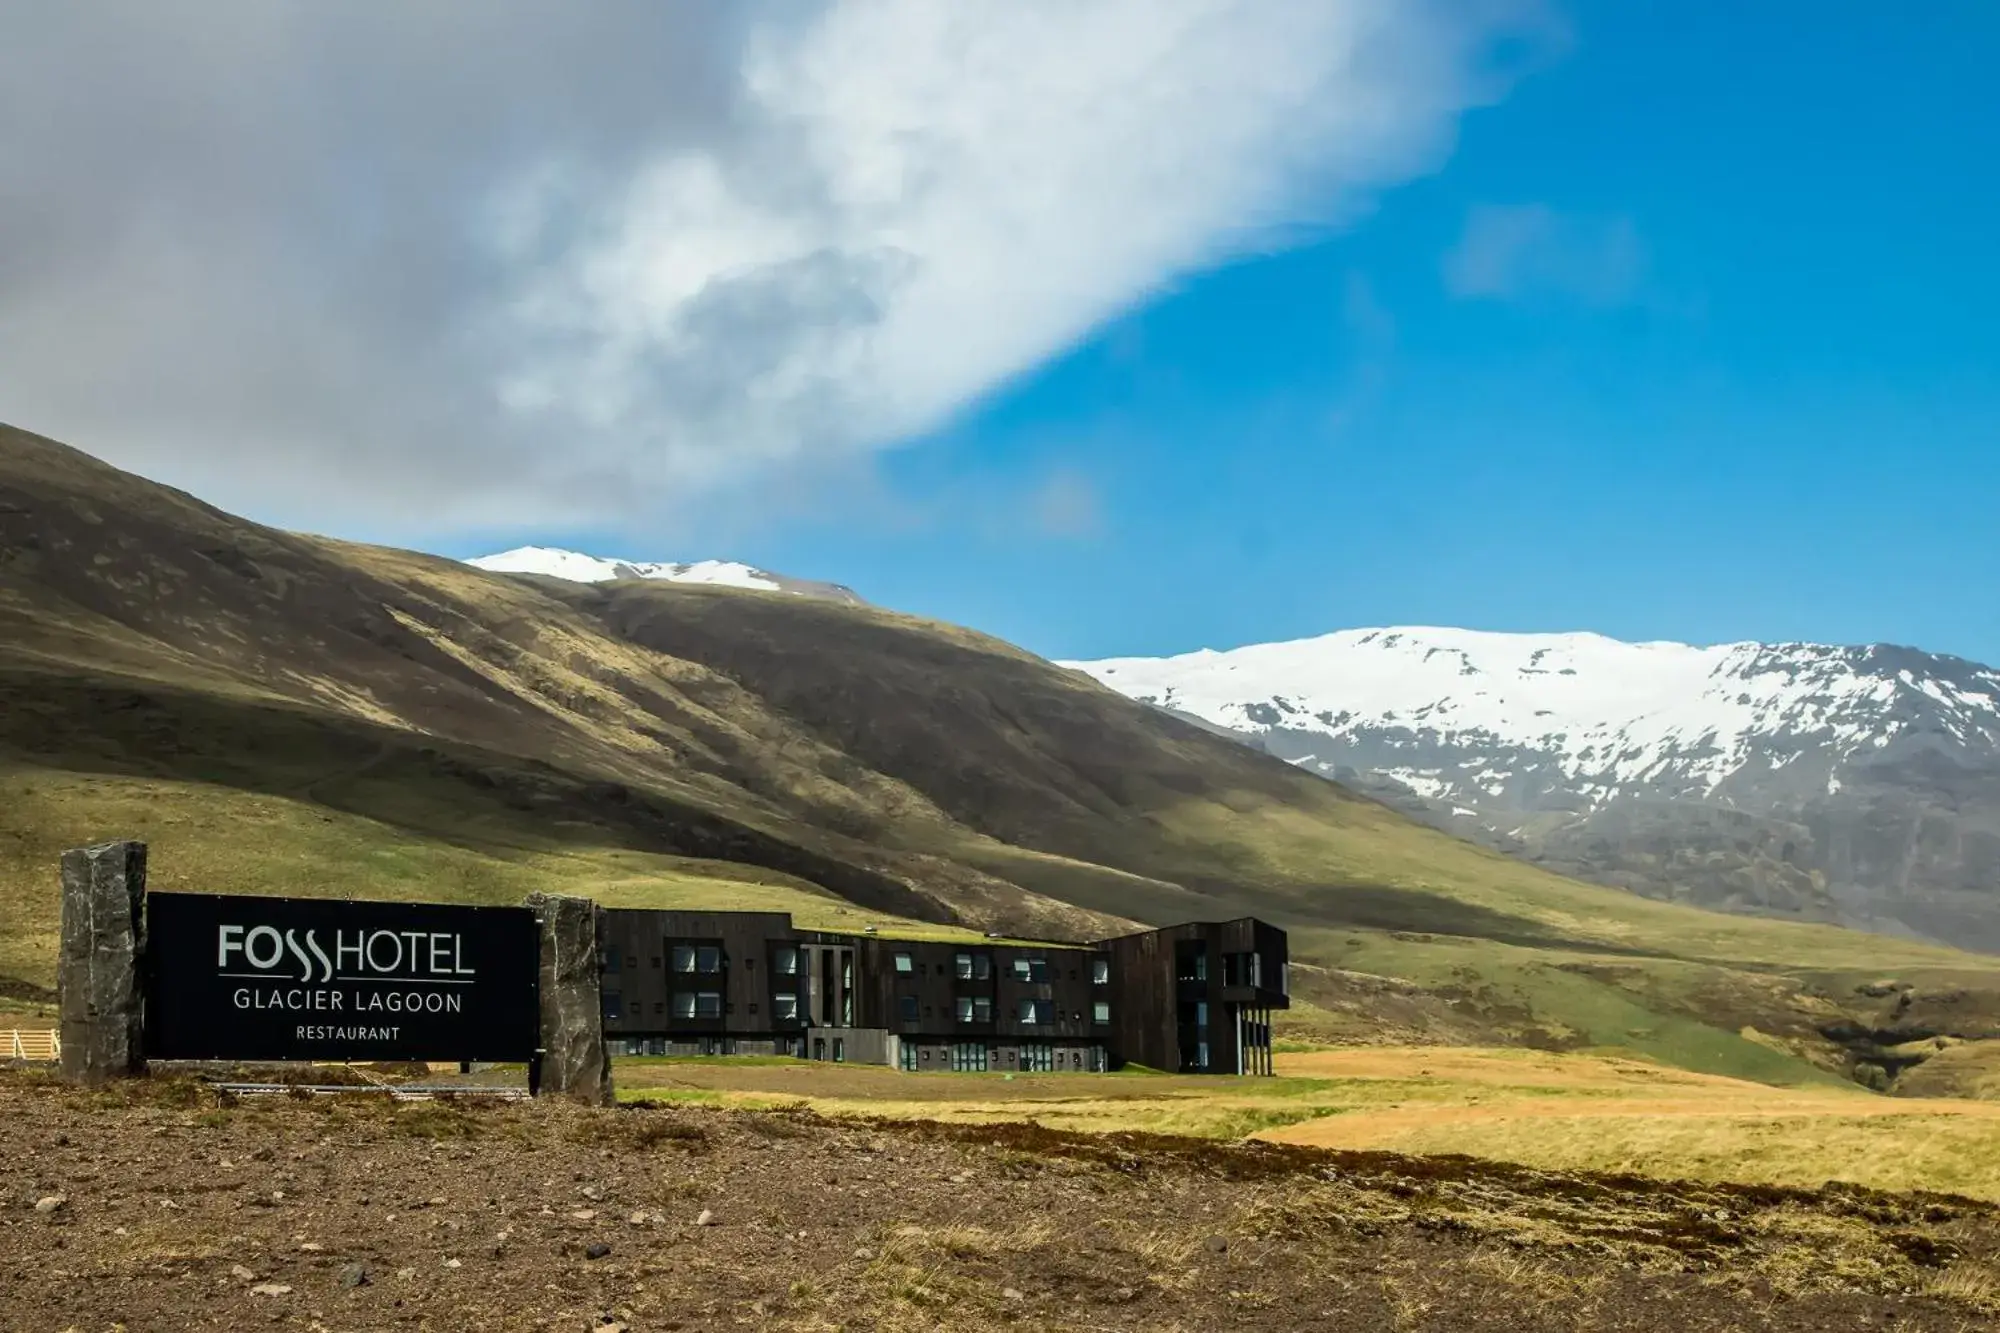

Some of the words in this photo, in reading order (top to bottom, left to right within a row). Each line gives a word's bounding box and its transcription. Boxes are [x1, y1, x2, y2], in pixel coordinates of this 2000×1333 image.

[233, 988, 343, 1010] GLACIER
[356, 991, 461, 1013] LAGOON
[296, 1025, 400, 1040] RESTAURANT
